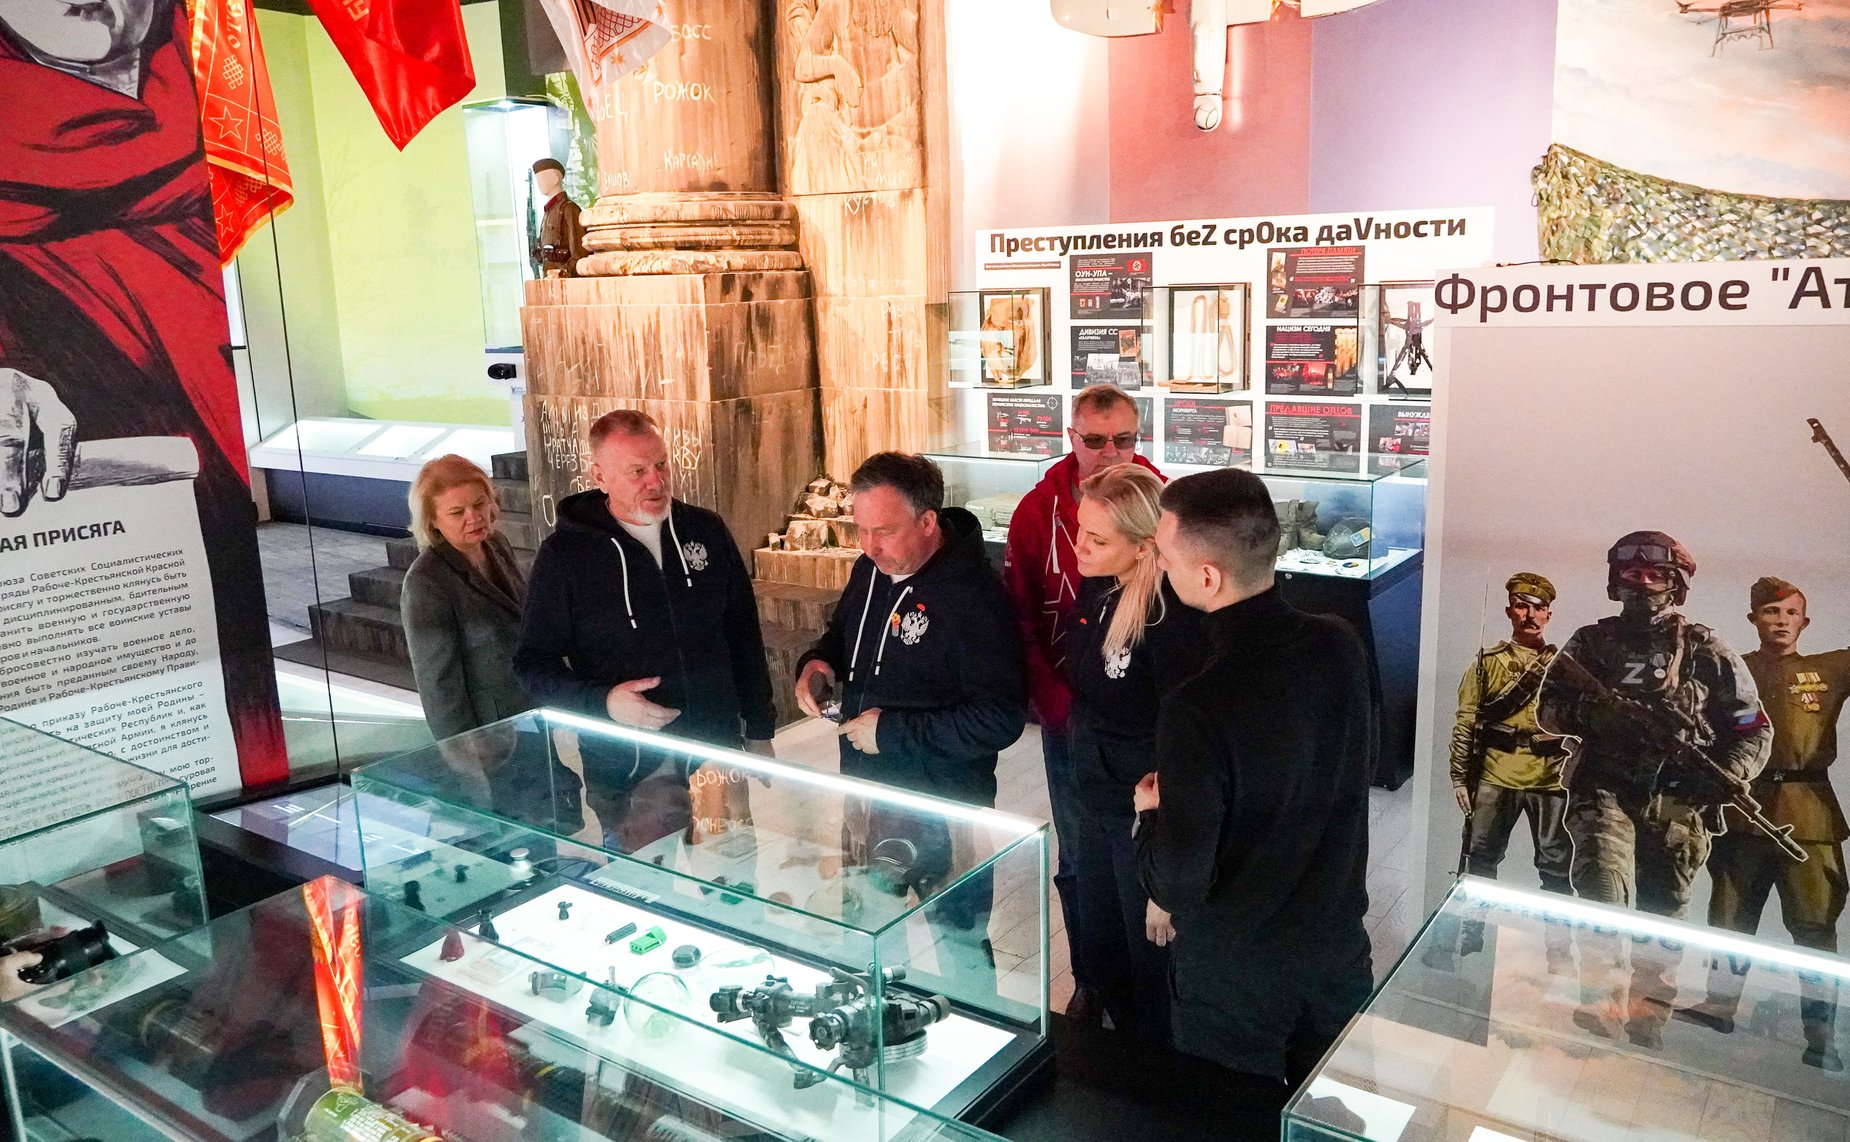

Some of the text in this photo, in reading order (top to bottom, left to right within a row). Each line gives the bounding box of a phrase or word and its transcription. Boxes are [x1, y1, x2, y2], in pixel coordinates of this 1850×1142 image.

[652, 80, 717, 104] РОЖОК
[990, 217, 1466, 257] Преступления беZ срОка даVности
[1074, 270, 1108, 278] ОУН-УПА
[1435, 265, 1850, 323] Фронтовое "Ат
[1269, 404, 1322, 415] ПРЕДАВШИЕ
[33, 520, 126, 548] ПРИСЯГА
[1, 559, 186, 600] ряды Рабоче-Крестьянской Красной
[30, 565, 86, 582] Советских
[91, 549, 184, 571] Социалистических
[47, 584, 121, 603] торжественно
[123, 577, 162, 589] клянусь
[163, 572, 187, 581] быть
[129, 582, 189, 600] бдительным
[38, 614, 86, 630] военную
[102, 593, 190, 617] государственную
[0, 604, 192, 651] вно выполнять все воинские уставы
[76, 644, 118, 658] изучать
[123, 633, 165, 648] военное
[1, 671, 47, 688] военное
[63, 656, 112, 673] народное
[116, 643, 171, 661] имущество
[185, 637, 197, 646] до
[25, 682, 52, 695] быть
[57, 668, 117, 687] преданным
[121, 658, 157, 672] своему
[1621, 662, 1647, 684] Z
[39, 696, 47, 704] и
[49, 668, 165, 701] Рабоче-Крестьянскому
[166, 660, 200, 673] Прави-
[42, 681, 203, 727] приказу Рабоче-Крестьянского
[66, 724, 79, 733] на
[84, 713, 123, 728] защиту
[127, 704, 154, 717] моей
[157, 694, 195, 709] Родины
[121, 712, 173, 730] Республик
[190, 702, 206, 712] как
[170, 714, 208, 728] клянусь
[121, 746, 126, 754] с
[131, 726, 199, 751] достоинством
[127, 750, 158, 762] жизни
[161, 743, 178, 754] для
[181, 736, 211, 748] дости-
[170, 762, 190, 774] мою
[179, 766, 216, 782] суровая
